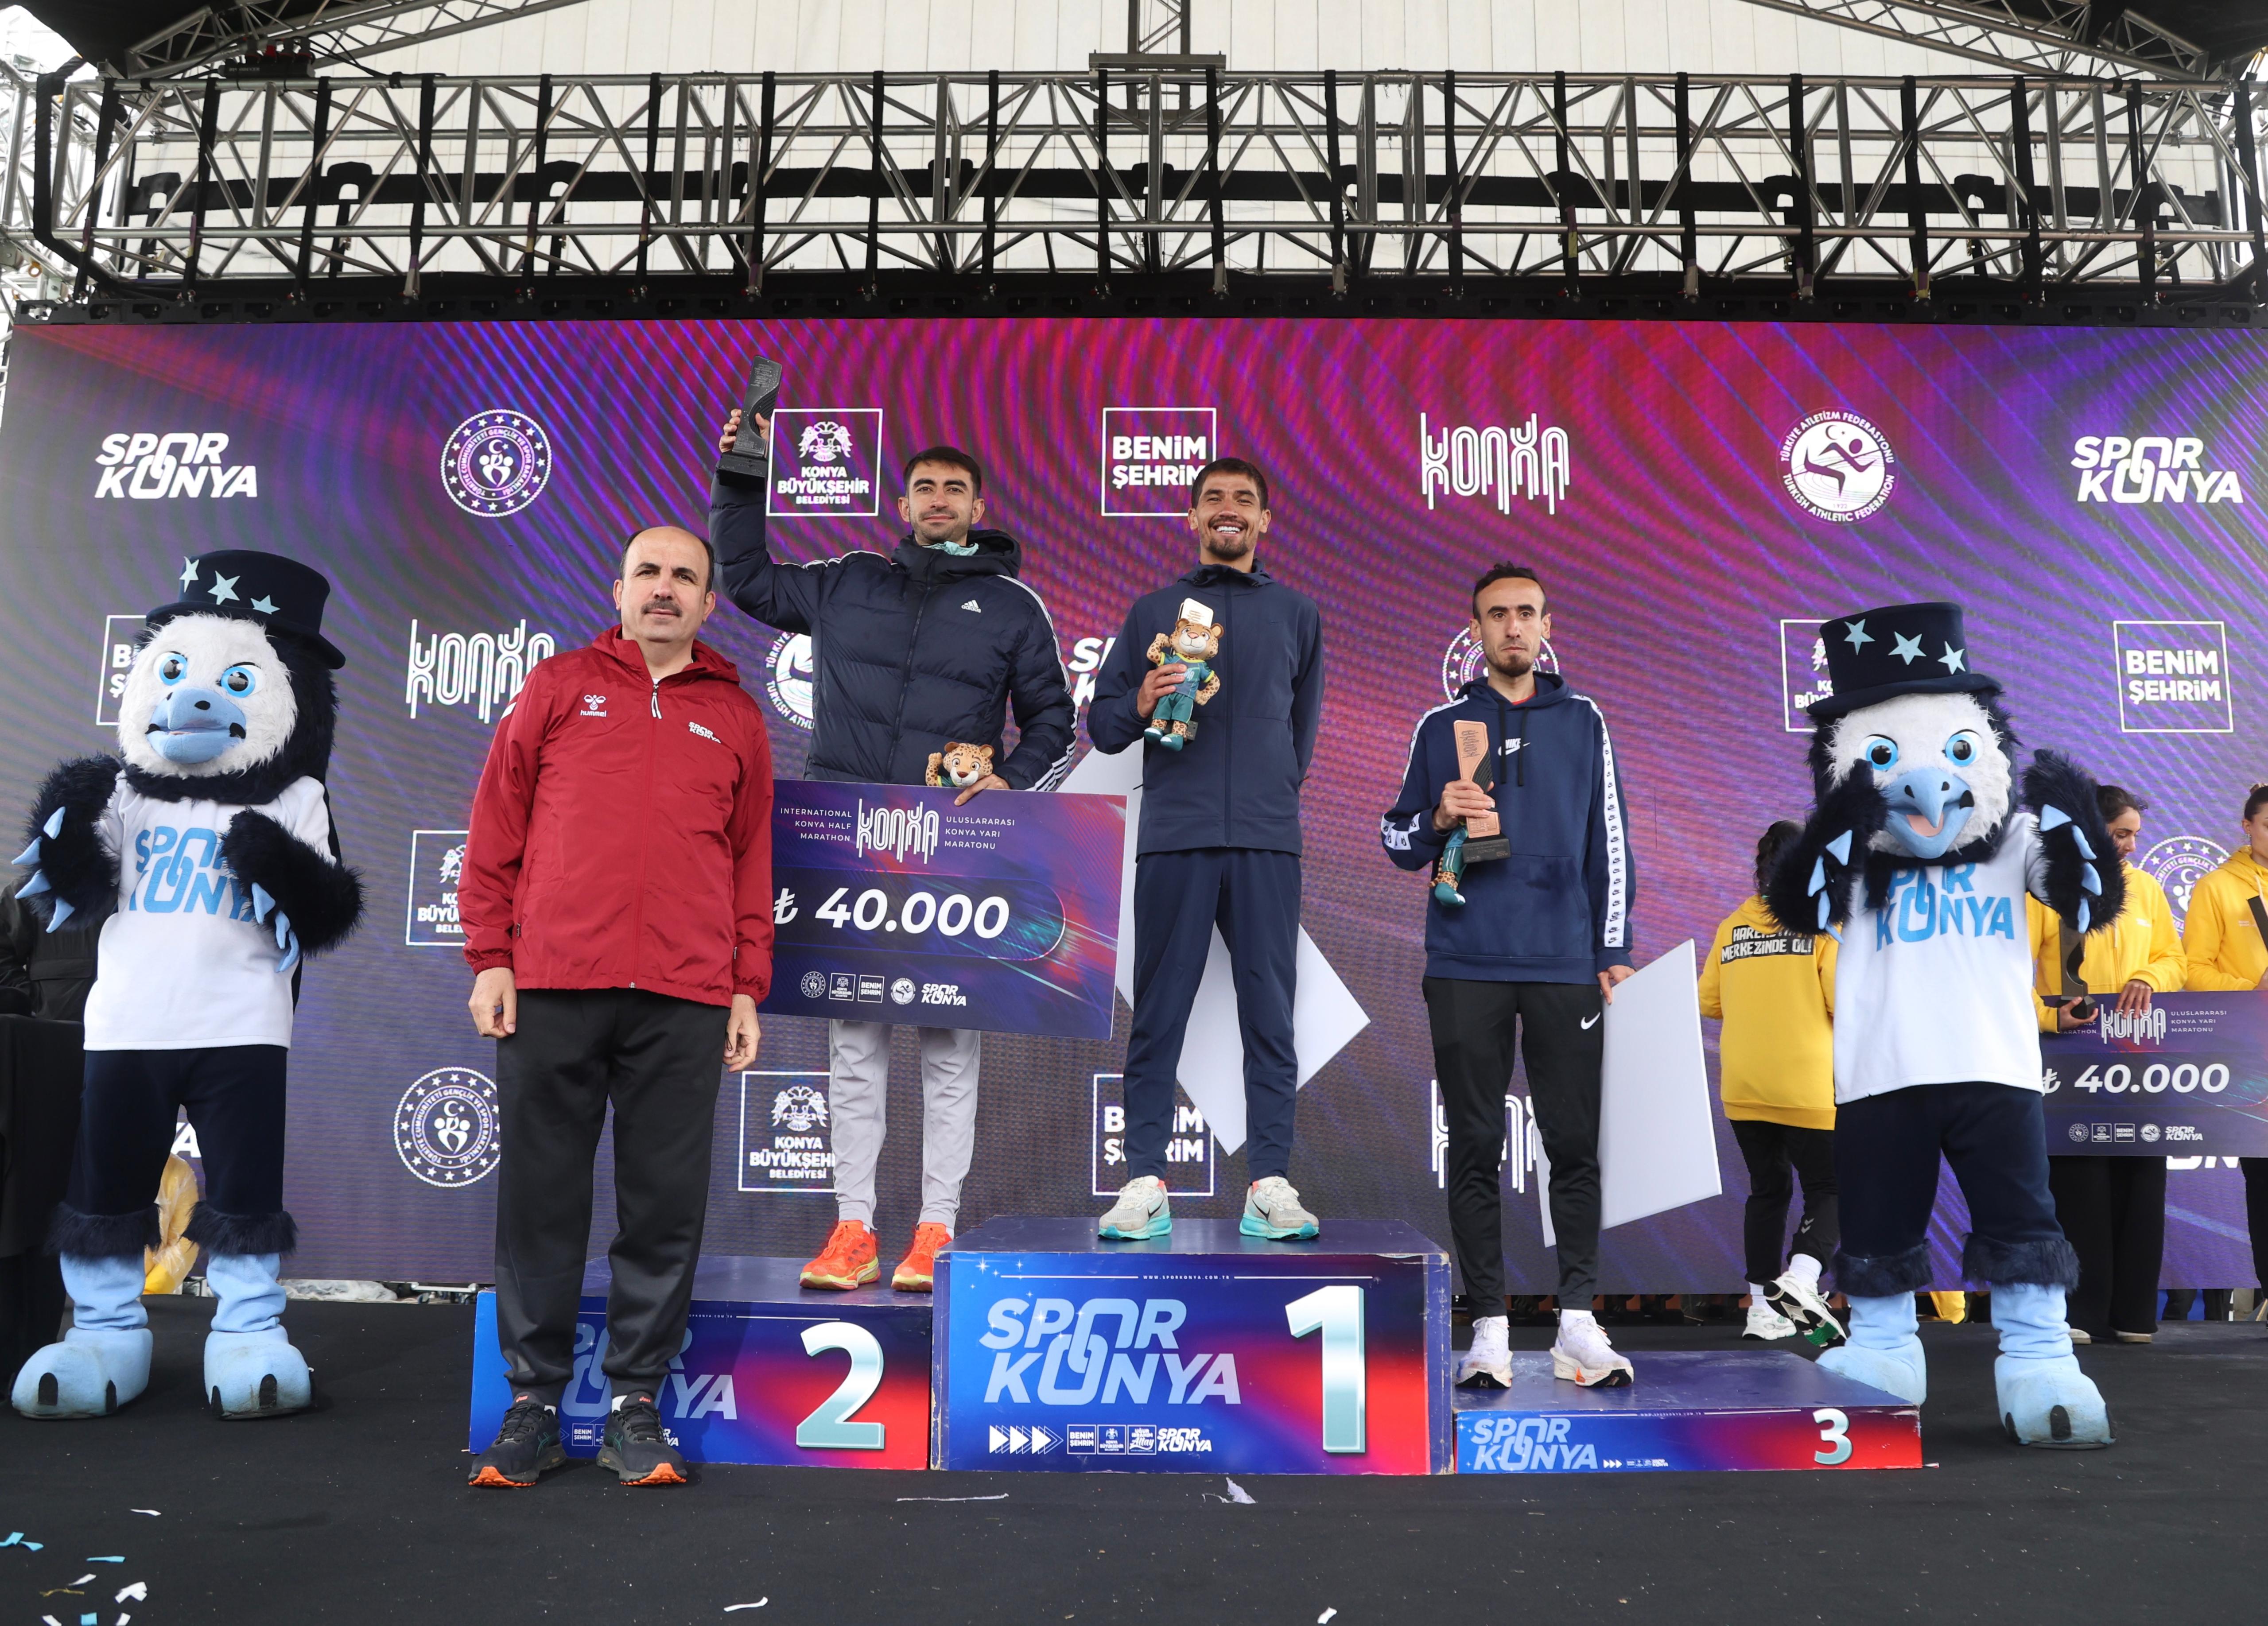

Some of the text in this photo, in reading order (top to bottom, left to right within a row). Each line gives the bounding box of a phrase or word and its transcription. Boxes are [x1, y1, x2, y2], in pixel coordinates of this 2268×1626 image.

[1112, 435, 1206, 460] BENİM
[1781, 411, 1895, 463] TÜRKİYE ATLETİZM FEDERASYONU
[95, 433, 229, 479] SPOR
[2070, 436, 2203, 484] SPOR
[94, 455, 258, 499] KONYA
[801, 466, 847, 477] KONYA
[2077, 458, 2244, 503] KONYA
[777, 477, 869, 496] BÜYÜKŞEHİR
[796, 494, 850, 504] BELEDİYESİ
[1783, 473, 1895, 522] TURKISH ATHLETIC FEDERATION
[961, 605, 981, 613] adidas
[765, 632, 790, 668] TÜRKİYE
[2126, 649, 2218, 674] BENİM
[766, 681, 791, 717] TURKISH
[2129, 680, 2221, 705] ŞEHRİM
[688, 722, 713, 736] SPOR
[690, 727, 721, 744] KONYA
[1505, 738, 1521, 749] NIKE
[781, 807, 852, 818] INTERNATIONAL
[946, 816, 1015, 826] ULUSLARARASI
[800, 833, 850, 842] MARATHON
[944, 841, 995, 849] MARATONU
[136, 826, 227, 886] SPO
[815, 887, 1010, 939] 40.000
[1877, 883, 2014, 951] KONYA
[1721, 938, 1812, 962] MERKEZİNDE OL!
[921, 983, 958, 998] SPOR
[921, 991, 966, 1006] KONYA
[2074, 1063, 2230, 1093] 40.000
[775, 1137, 823, 1149] KONYA
[2165, 1126, 2195, 1135] SPOR
[2166, 1130, 2203, 1141] KONYA
[769, 1168, 826, 1178] BELEDİYESİ
[979, 1298, 1187, 1374] SPOR
[984, 1334, 1241, 1405] KONYA
[1285, 1285, 1366, 1454] 1
[796, 1322, 885, 1449] 2
[1130, 1437, 1154, 1450] Altay
[1157, 1428, 1200, 1445] SPOR
[1158, 1436, 1212, 1451] KONYA
[1472, 1418, 1571, 1453] SPOR
[1812, 1408, 1853, 1464] 3
[1474, 1436, 1597, 1471] KONYA
